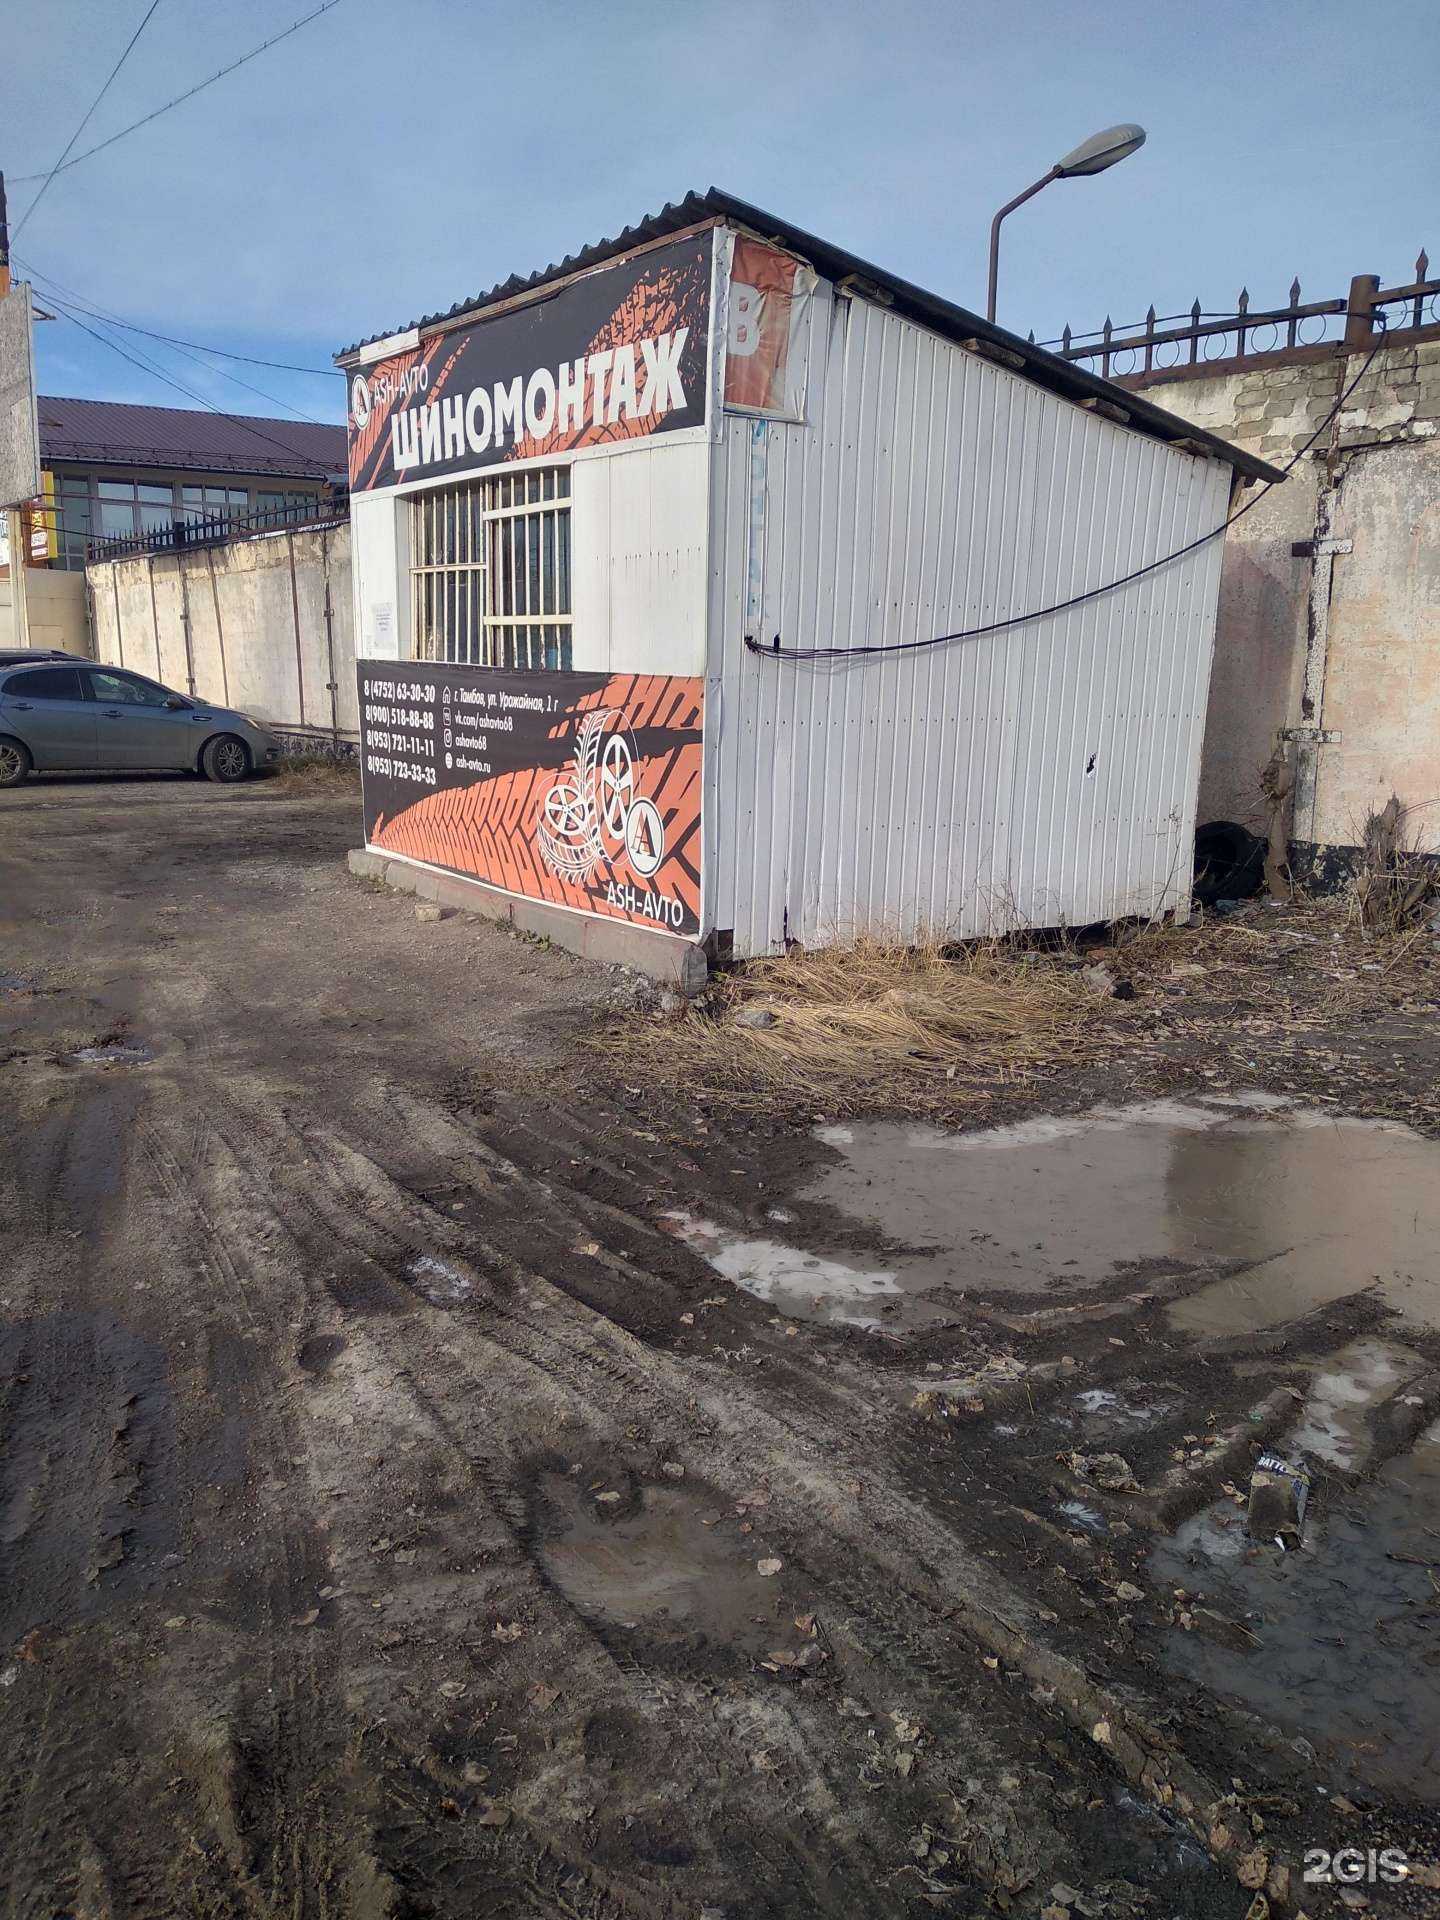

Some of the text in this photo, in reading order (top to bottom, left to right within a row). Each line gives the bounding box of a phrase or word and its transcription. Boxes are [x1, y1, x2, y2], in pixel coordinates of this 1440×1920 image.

[374, 364, 428, 406] ASH-AVTO
[390, 327, 690, 471] ШИНОМОНТАЖ
[364, 680, 436, 703] 8 (4752) 63-30-30
[460, 687, 486, 707] Тамбов,
[487, 693, 497, 709] ул.
[500, 691, 544, 714] Урожайная,
[391, 707, 434, 730] 518-88-88
[455, 710, 513, 731] vk.com/ashavto68
[392, 733, 434, 757] 721-11-11
[455, 732, 487, 750] ashavto68
[393, 760, 436, 785] 723-33-33
[456, 754, 491, 773] ash-avto.ru
[607, 881, 684, 926] ASH-AVTO
